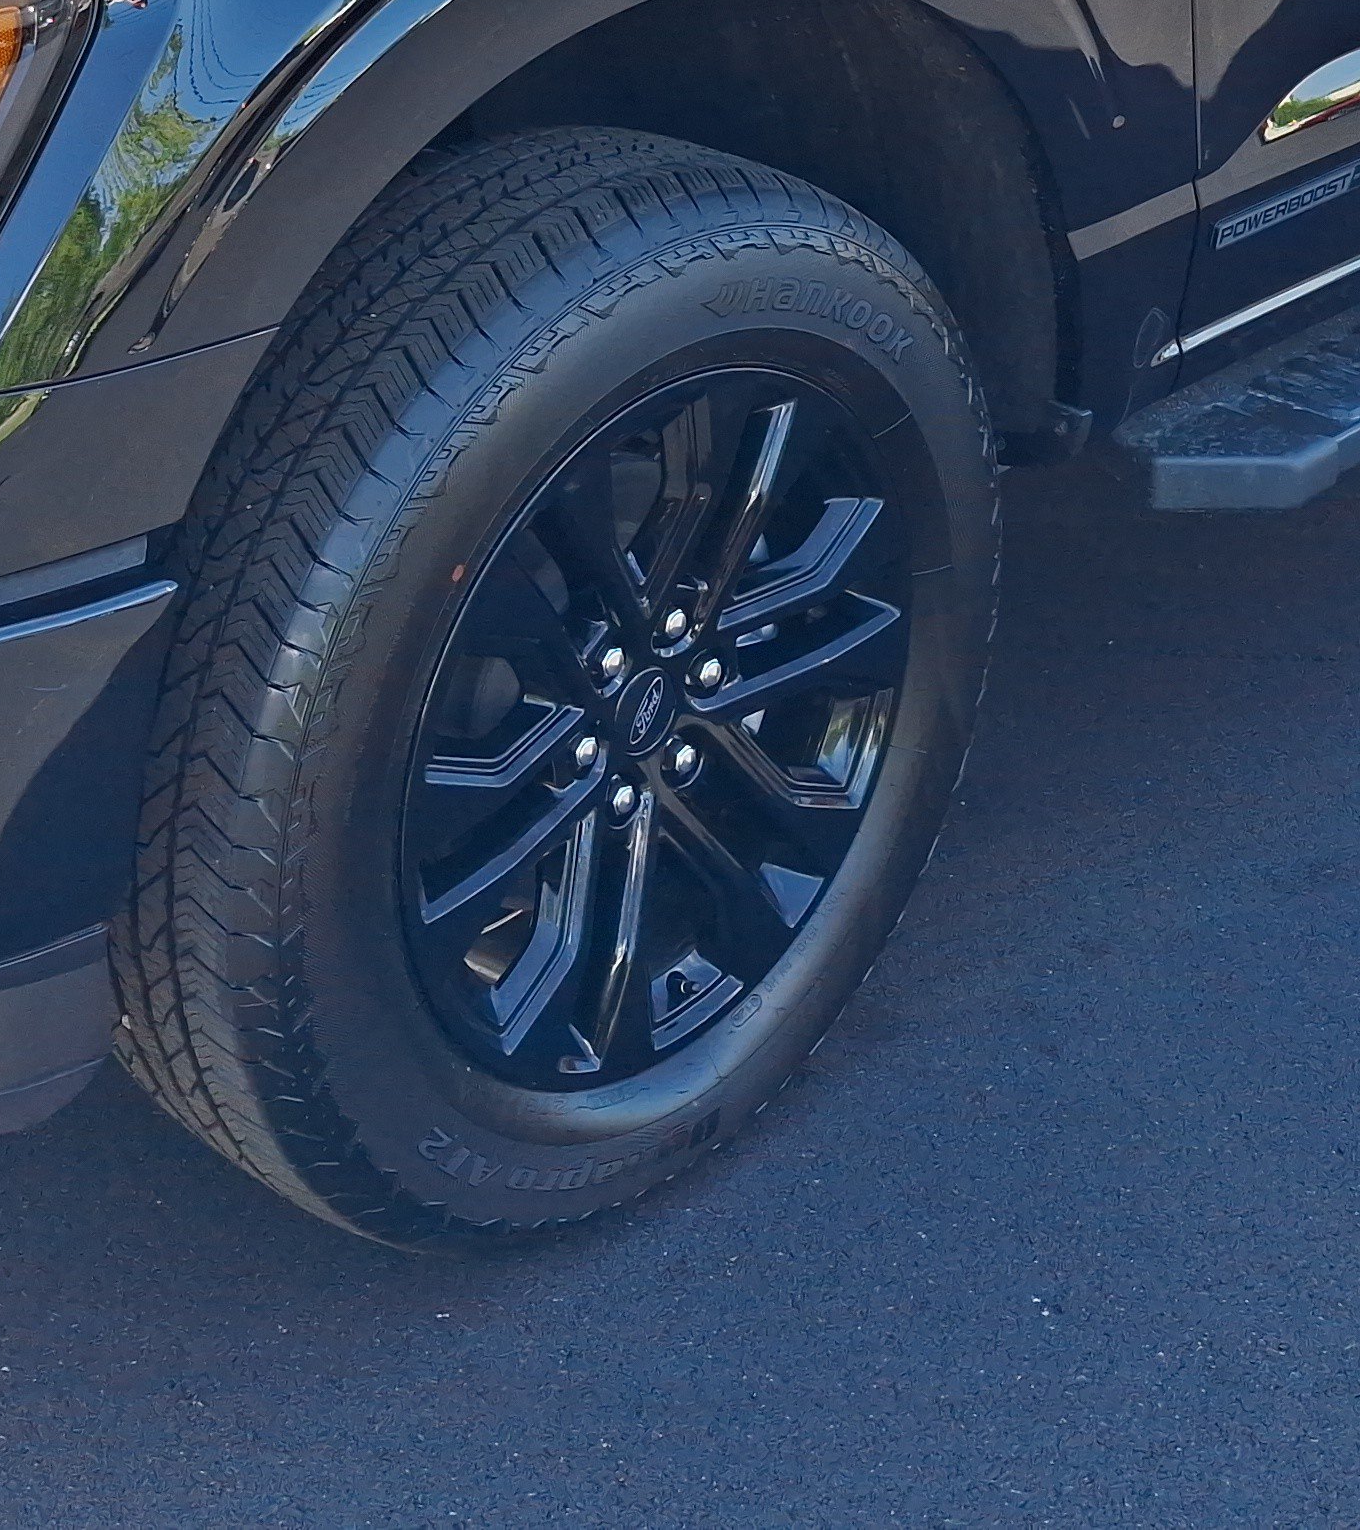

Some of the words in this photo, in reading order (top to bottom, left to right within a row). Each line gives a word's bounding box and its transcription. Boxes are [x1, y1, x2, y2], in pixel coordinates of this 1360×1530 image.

[1219, 173, 1352, 245] POWERBOOST
[635, 687, 661, 735] Ford
[504, 1107, 721, 1192] Dapro
